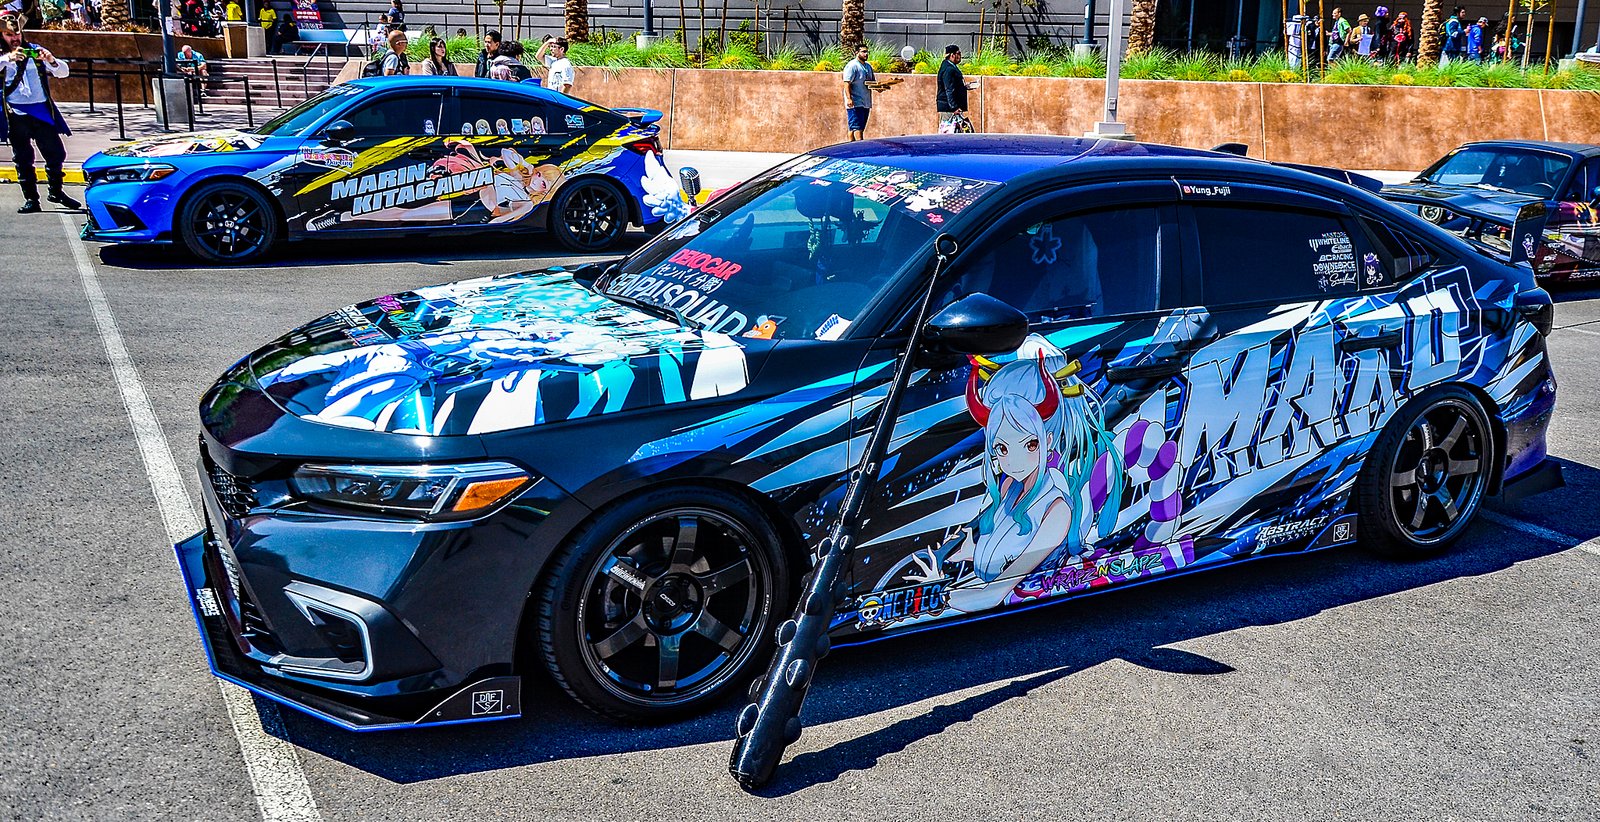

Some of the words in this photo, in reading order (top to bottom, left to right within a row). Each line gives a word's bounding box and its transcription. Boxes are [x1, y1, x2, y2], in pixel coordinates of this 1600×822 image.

[330, 162, 427, 200] MARIN
[351, 166, 494, 216] KITAGAWA
[1318, 237, 1350, 245] WHITELINE
[1332, 253, 1354, 261] RACING
[1041, 567, 1099, 593] WRAPZ
[1098, 565, 1109, 578] N
[1110, 553, 1162, 577] SLAPZ
